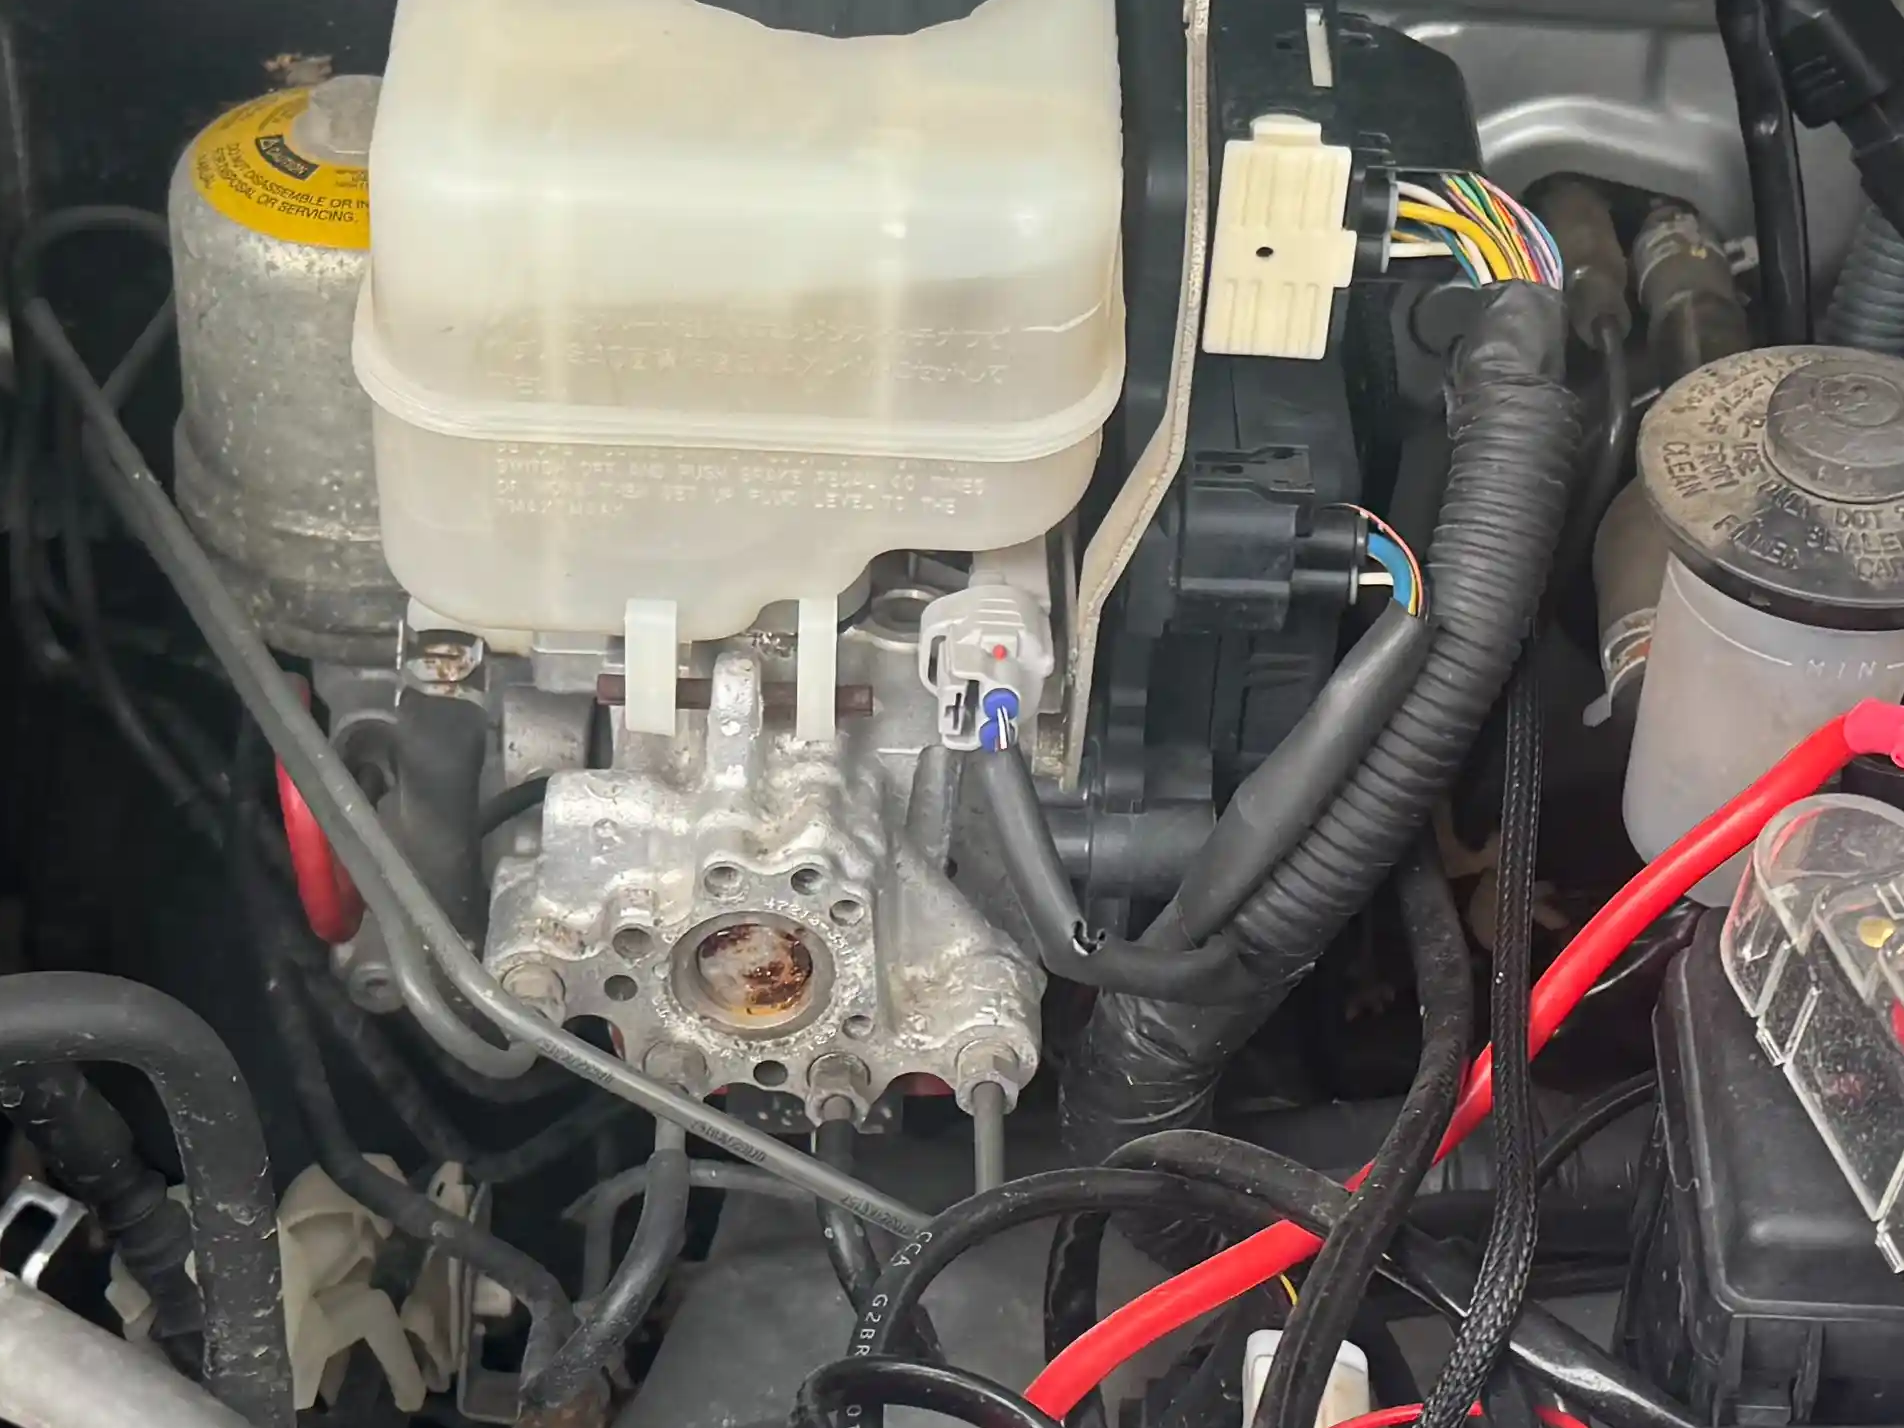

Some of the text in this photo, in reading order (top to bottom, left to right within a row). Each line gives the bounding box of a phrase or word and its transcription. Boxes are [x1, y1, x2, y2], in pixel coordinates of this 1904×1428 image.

[330, 199, 352, 209] OR
[1662, 441, 1709, 498] CLEAN
[1834, 508, 1883, 529] DOT
[1805, 658, 1877, 680] MIN
[890, 1231, 933, 1267] CCA
